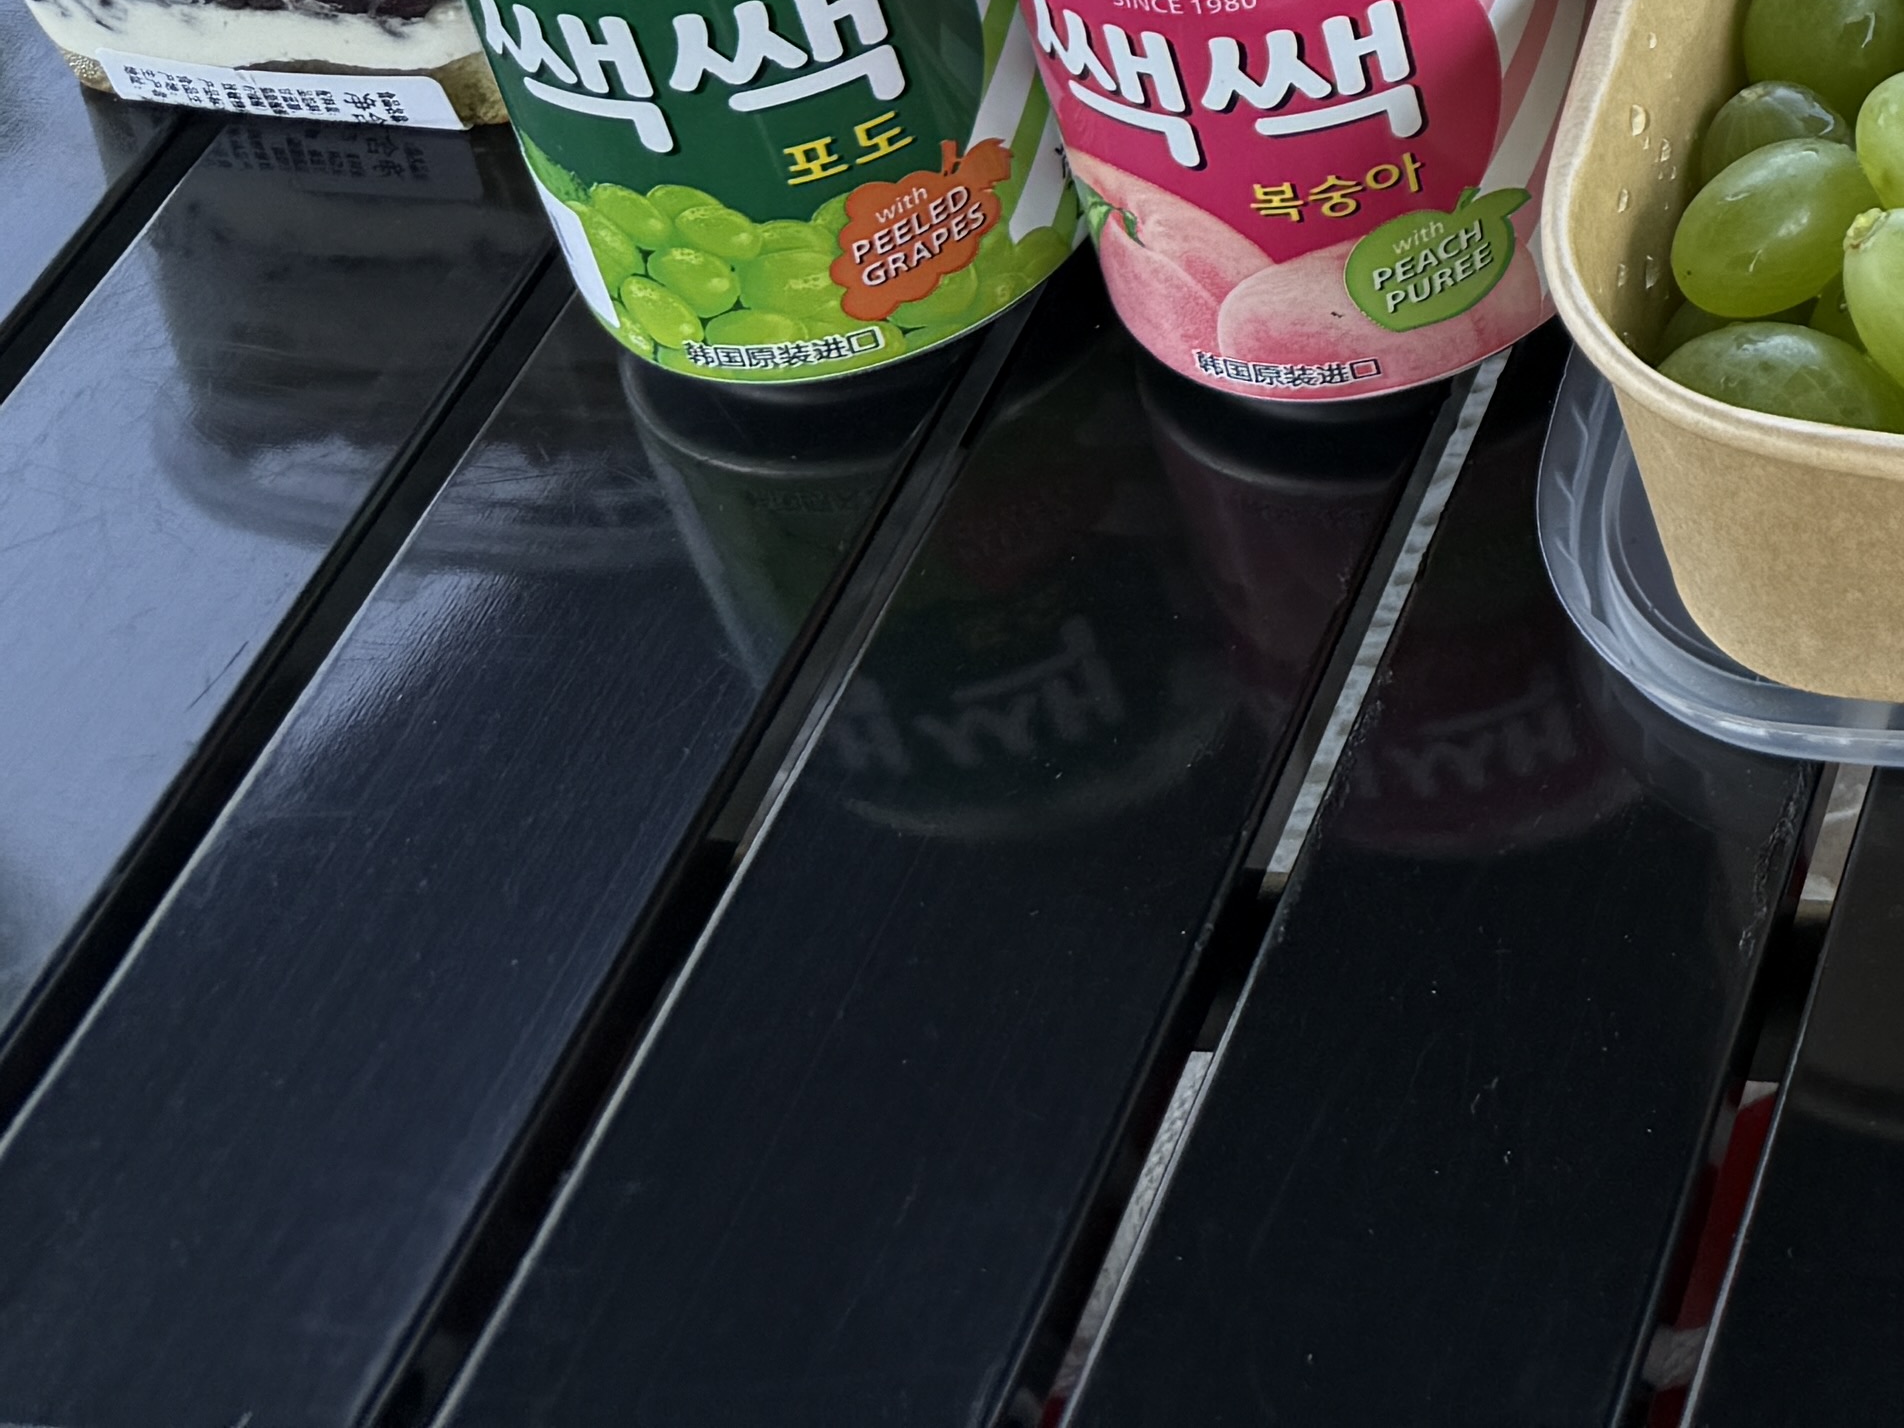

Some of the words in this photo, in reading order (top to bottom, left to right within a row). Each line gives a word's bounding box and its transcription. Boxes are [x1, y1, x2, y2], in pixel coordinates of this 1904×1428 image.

[782, 110, 917, 187] 포도
[874, 183, 929, 225] with
[1249, 150, 1424, 222] 복숭아
[851, 185, 972, 265] PEELED
[860, 203, 988, 288] GRAPES
[1372, 219, 1486, 292] PEACH
[1391, 218, 1446, 257] with
[1386, 242, 1495, 315] PUREE
[683, 328, 886, 370] 韩国原装进口
[1195, 350, 1383, 387] 韩国原装进口
